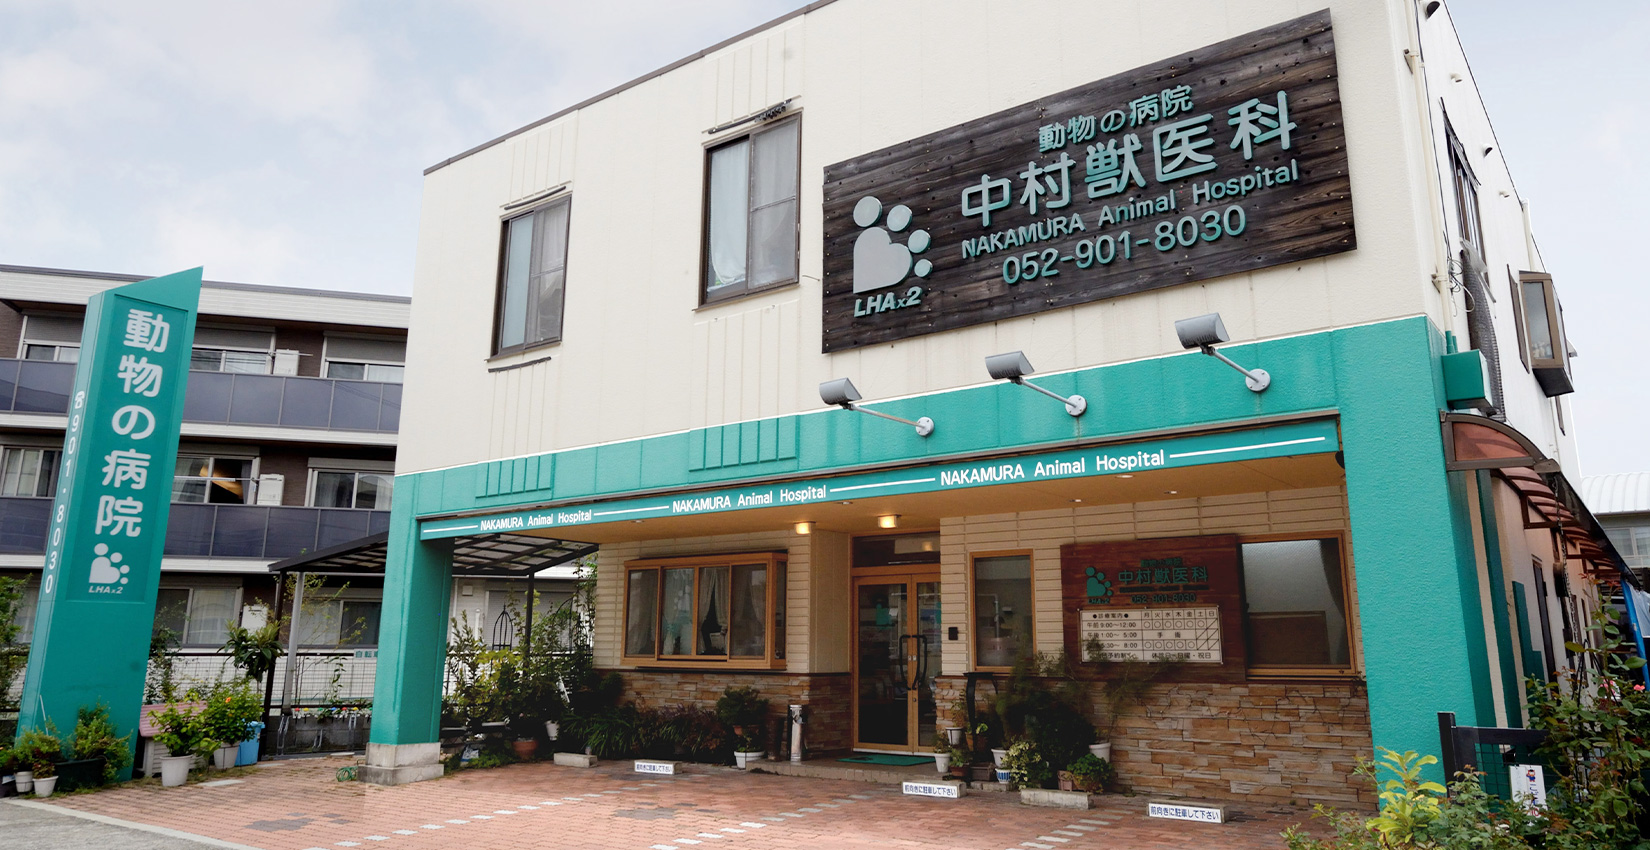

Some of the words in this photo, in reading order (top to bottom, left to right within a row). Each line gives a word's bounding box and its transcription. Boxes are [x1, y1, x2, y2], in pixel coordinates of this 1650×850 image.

[1039, 84, 1194, 153] 動物の病院
[961, 90, 1298, 227] 中村獣医科
[962, 212, 1086, 259] NAKAMURA
[1097, 189, 1176, 227] Animal
[1192, 158, 1299, 206] Hospital
[1002, 204, 1246, 285] 052-901-8030
[94, 308, 170, 538] 動物の病院
[940, 463, 1025, 486] NAKAMURA
[1034, 457, 1086, 477] Animal
[1096, 449, 1165, 471] Hospital
[672, 495, 731, 513] NAKAMURA
[737, 490, 773, 507] Animal
[780, 484, 827, 502] Hospital
[480, 516, 523, 531] NAKAMURA
[527, 513, 553, 526] Animal
[558, 509, 592, 524] Hospital
[1118, 566, 1208, 585] 中村獣医科
[1131, 593, 1197, 604] 052-901-8030
[904, 784, 957, 796] 前向きに駐車して下さい
[1150, 805, 1219, 820] 前向きに駐車して下さい
